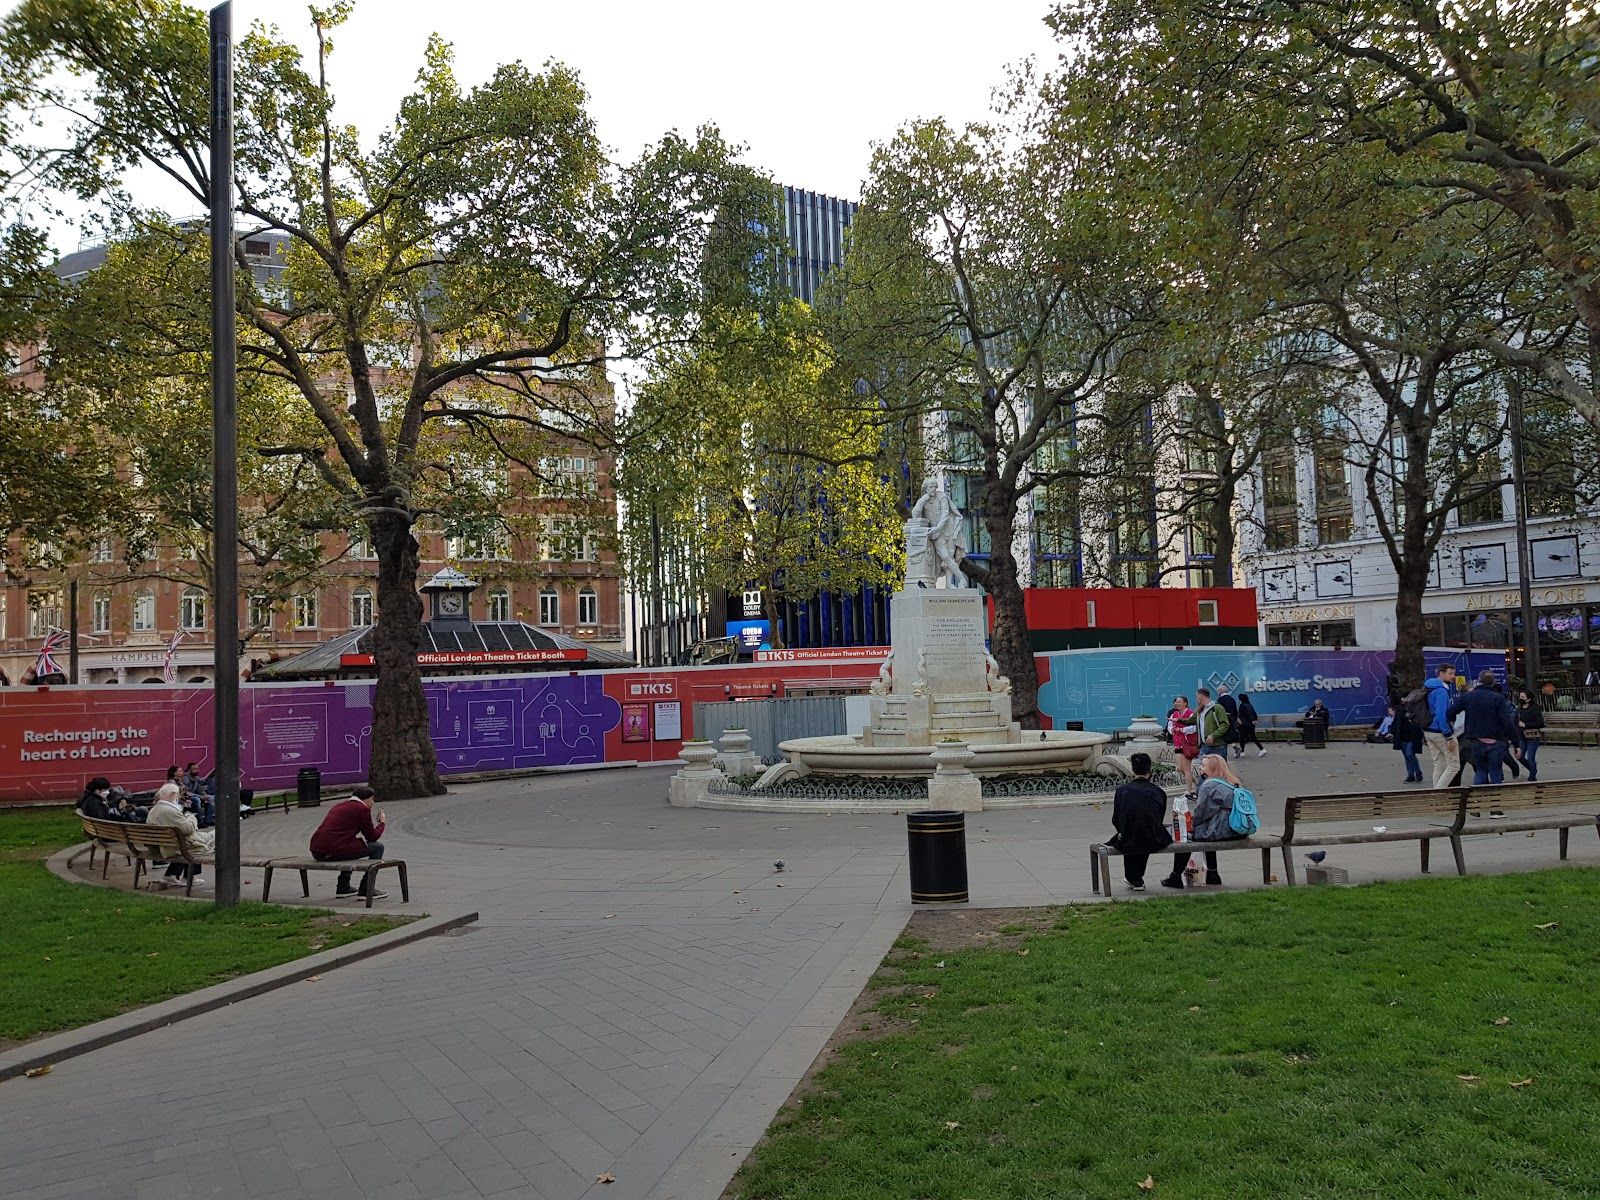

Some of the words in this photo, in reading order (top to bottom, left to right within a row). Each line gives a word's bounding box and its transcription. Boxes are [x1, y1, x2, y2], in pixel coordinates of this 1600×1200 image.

[1466, 595, 1495, 609] ALL
[1545, 586, 1585, 604] ONE
[1324, 605, 1355, 619] ONE
[742, 627, 763, 635] ODEON
[111, 652, 180, 662] HAMPSHIE
[417, 653, 449, 663] Official
[450, 652, 482, 662] London
[484, 652, 515, 661] Theatre
[516, 651, 540, 660] Ticket
[541, 651, 565, 660] Booth
[767, 651, 795, 661] TKTS
[642, 683, 673, 695] TKTS
[1244, 675, 1311, 692] Leicester
[1313, 674, 1361, 692] Square
[24, 727, 117, 744] Recharging
[120, 726, 148, 739] the
[20, 748, 66, 761] heart
[70, 746, 88, 759] of
[90, 744, 151, 759] London
